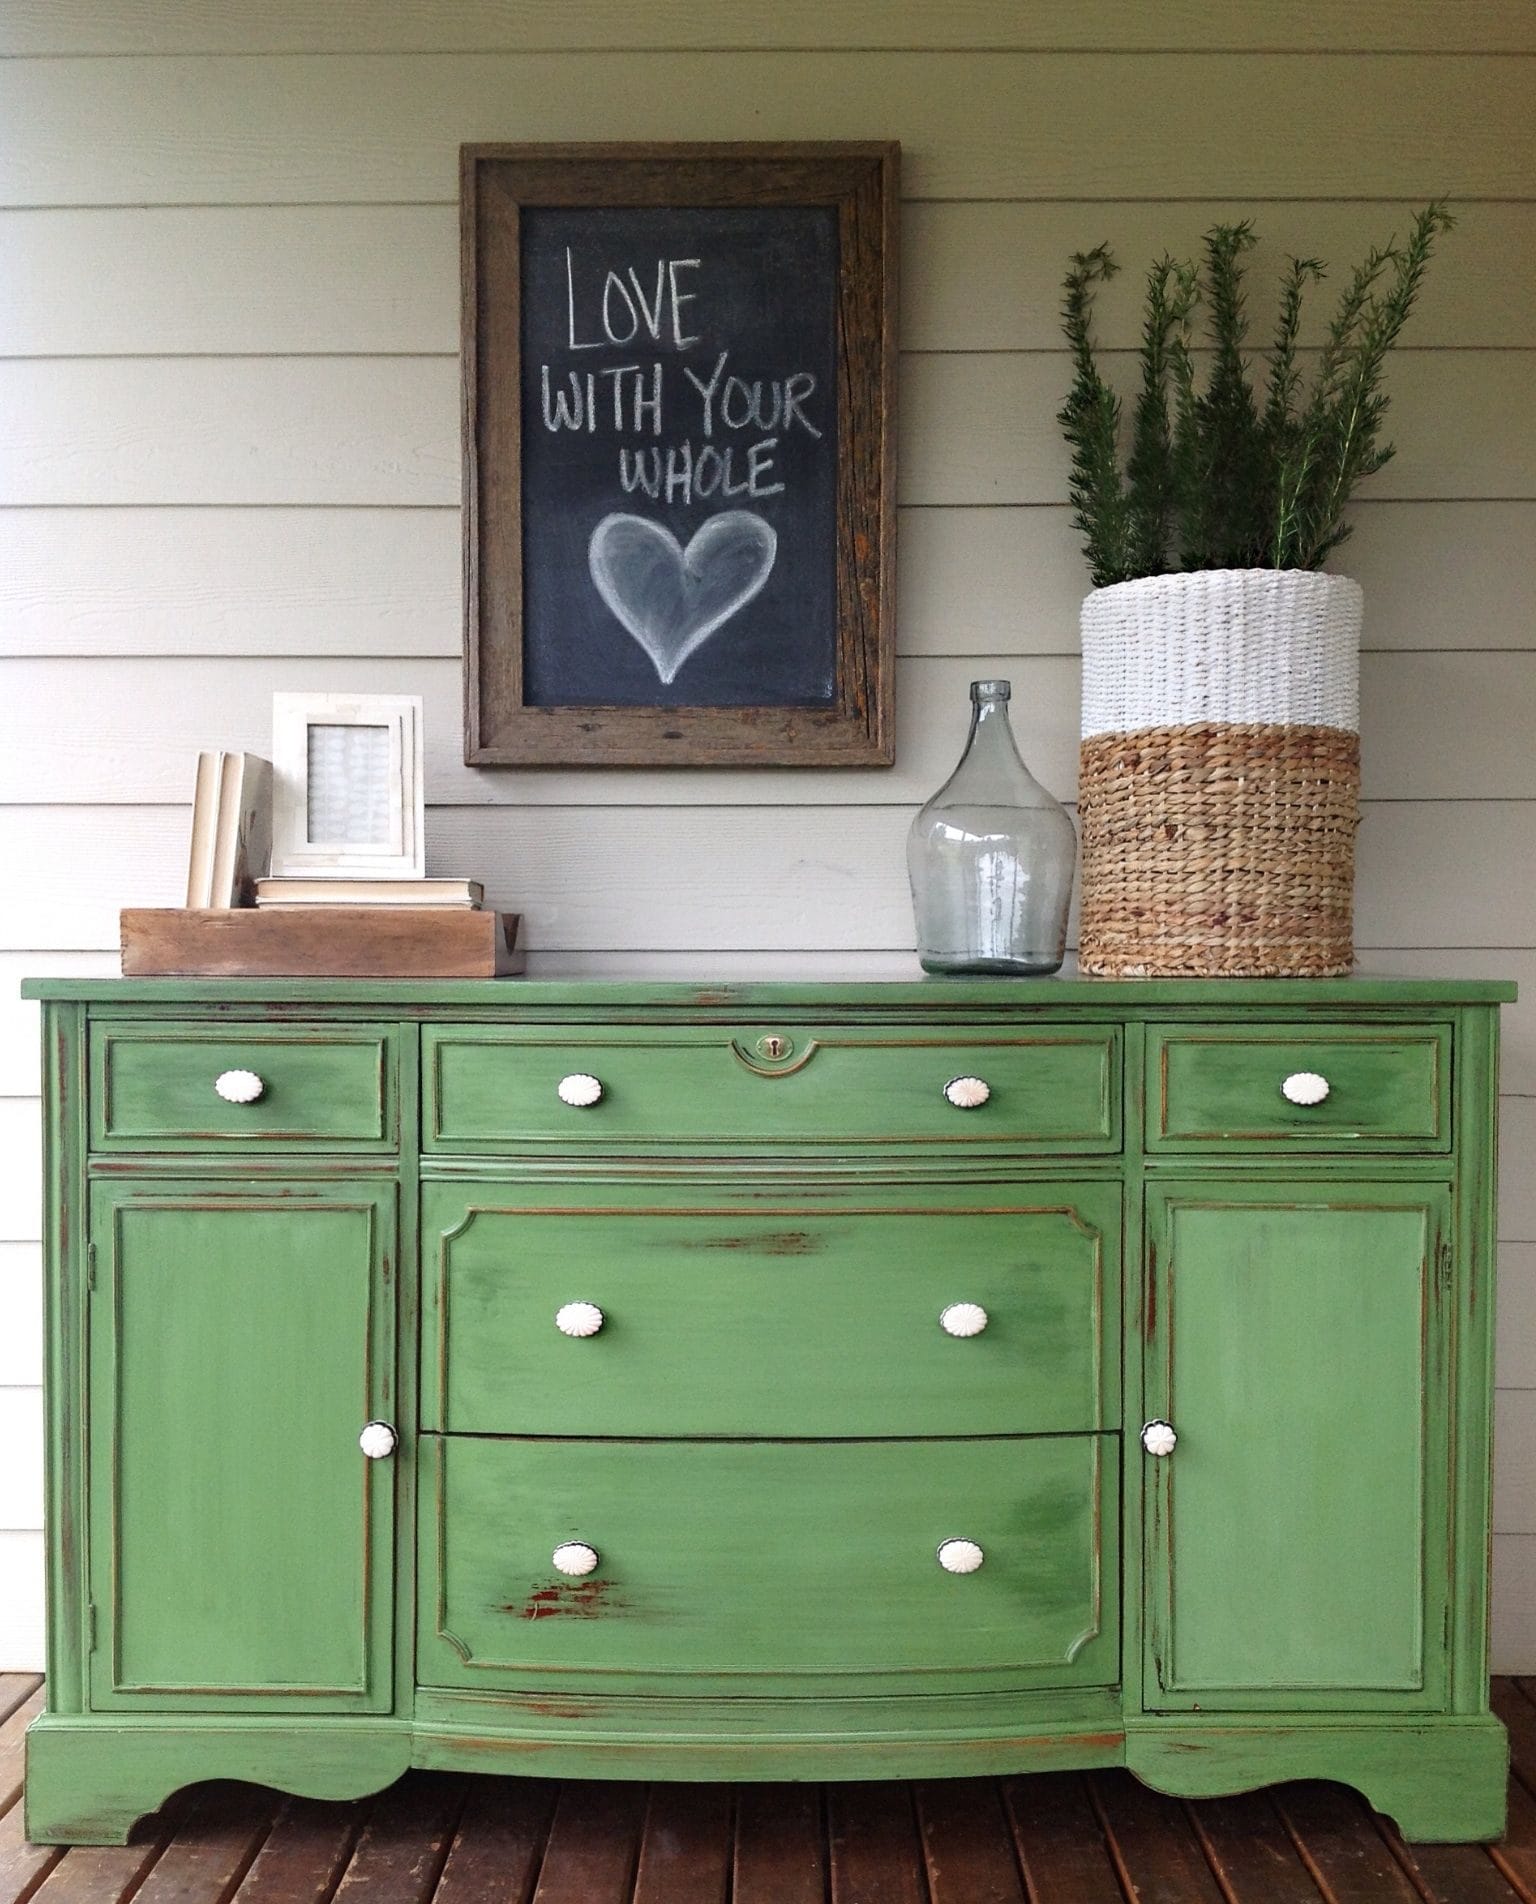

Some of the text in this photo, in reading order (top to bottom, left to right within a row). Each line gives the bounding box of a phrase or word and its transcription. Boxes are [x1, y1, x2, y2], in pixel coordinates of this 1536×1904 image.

[566, 246, 701, 350] LOVE
[541, 352, 822, 438] WITH YOUR
[619, 438, 785, 504] WHOLE
